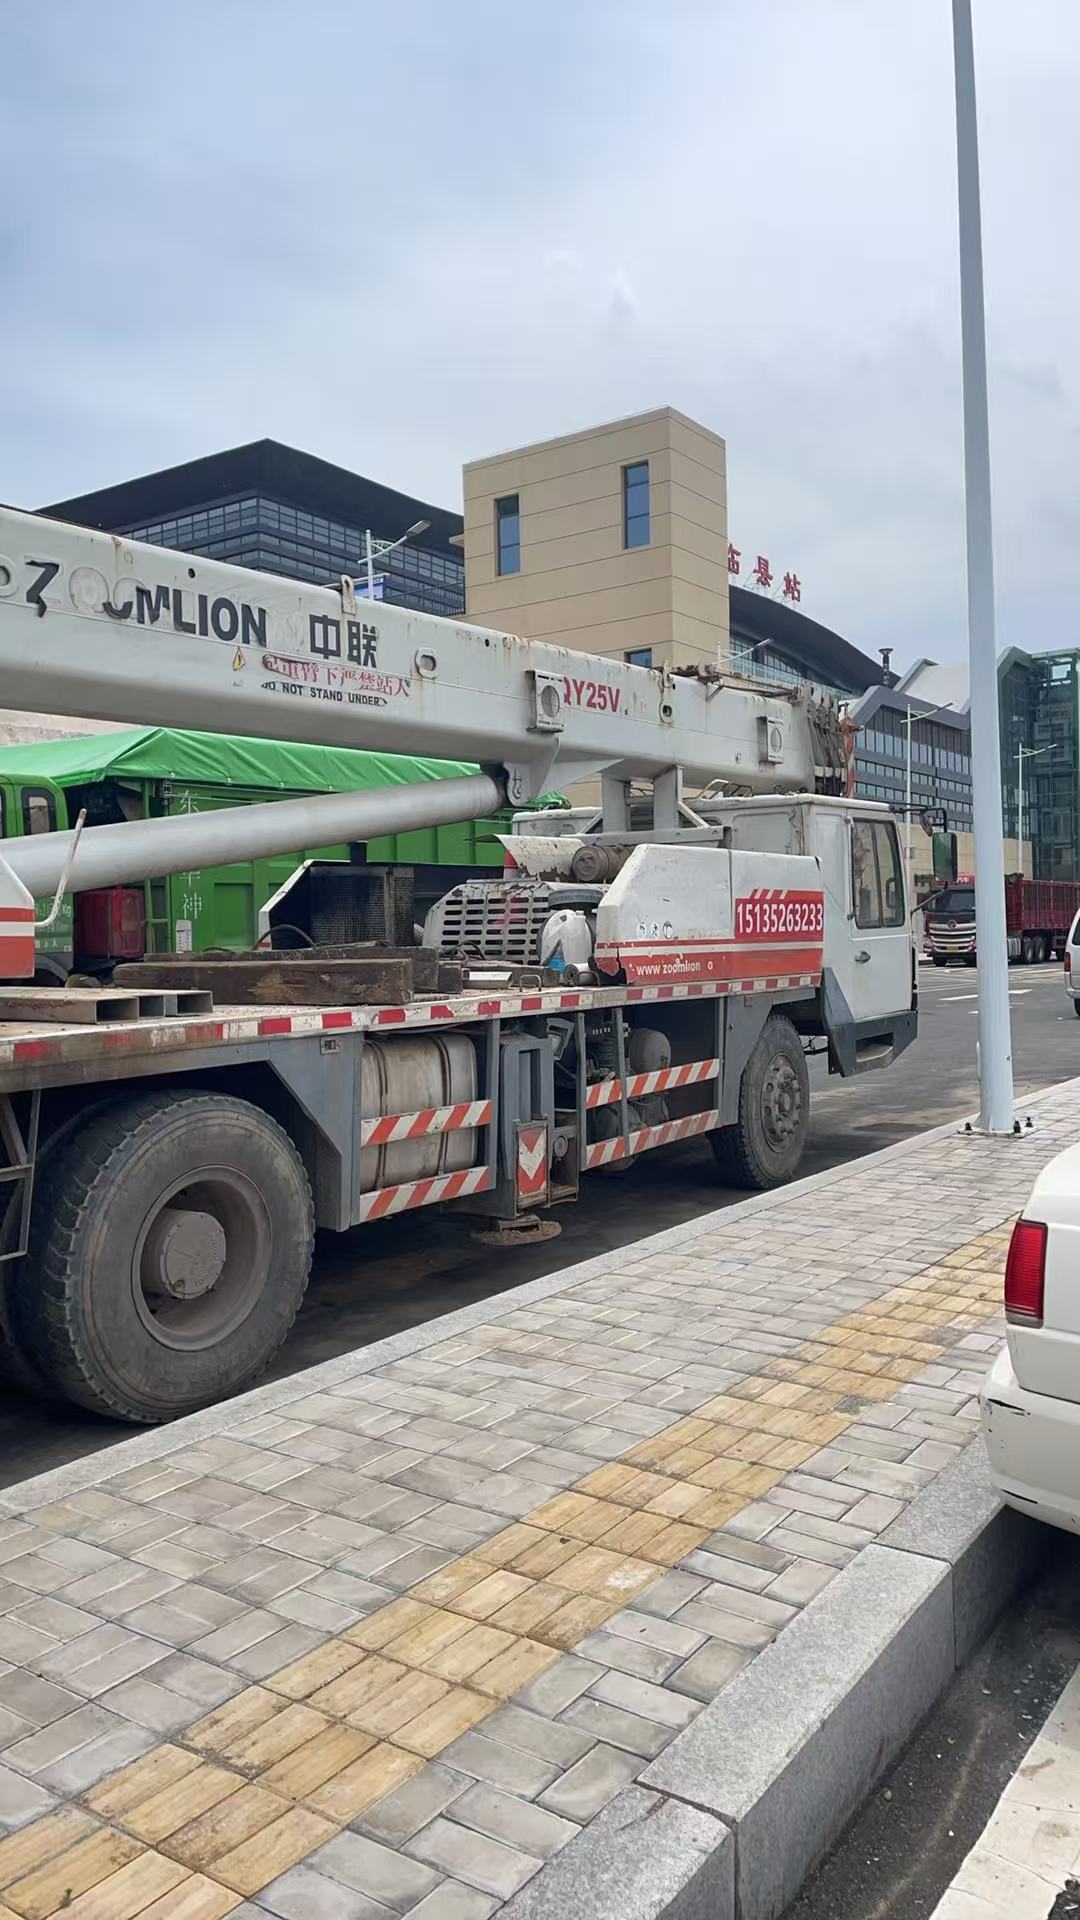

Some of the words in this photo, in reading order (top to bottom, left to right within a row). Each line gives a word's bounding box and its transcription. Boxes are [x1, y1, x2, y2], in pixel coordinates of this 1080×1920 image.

[309, 614, 377, 668] 中联
[281, 682, 304, 696] NOT
[310, 687, 342, 702] STAND
[737, 903, 823, 934] 15135263233
